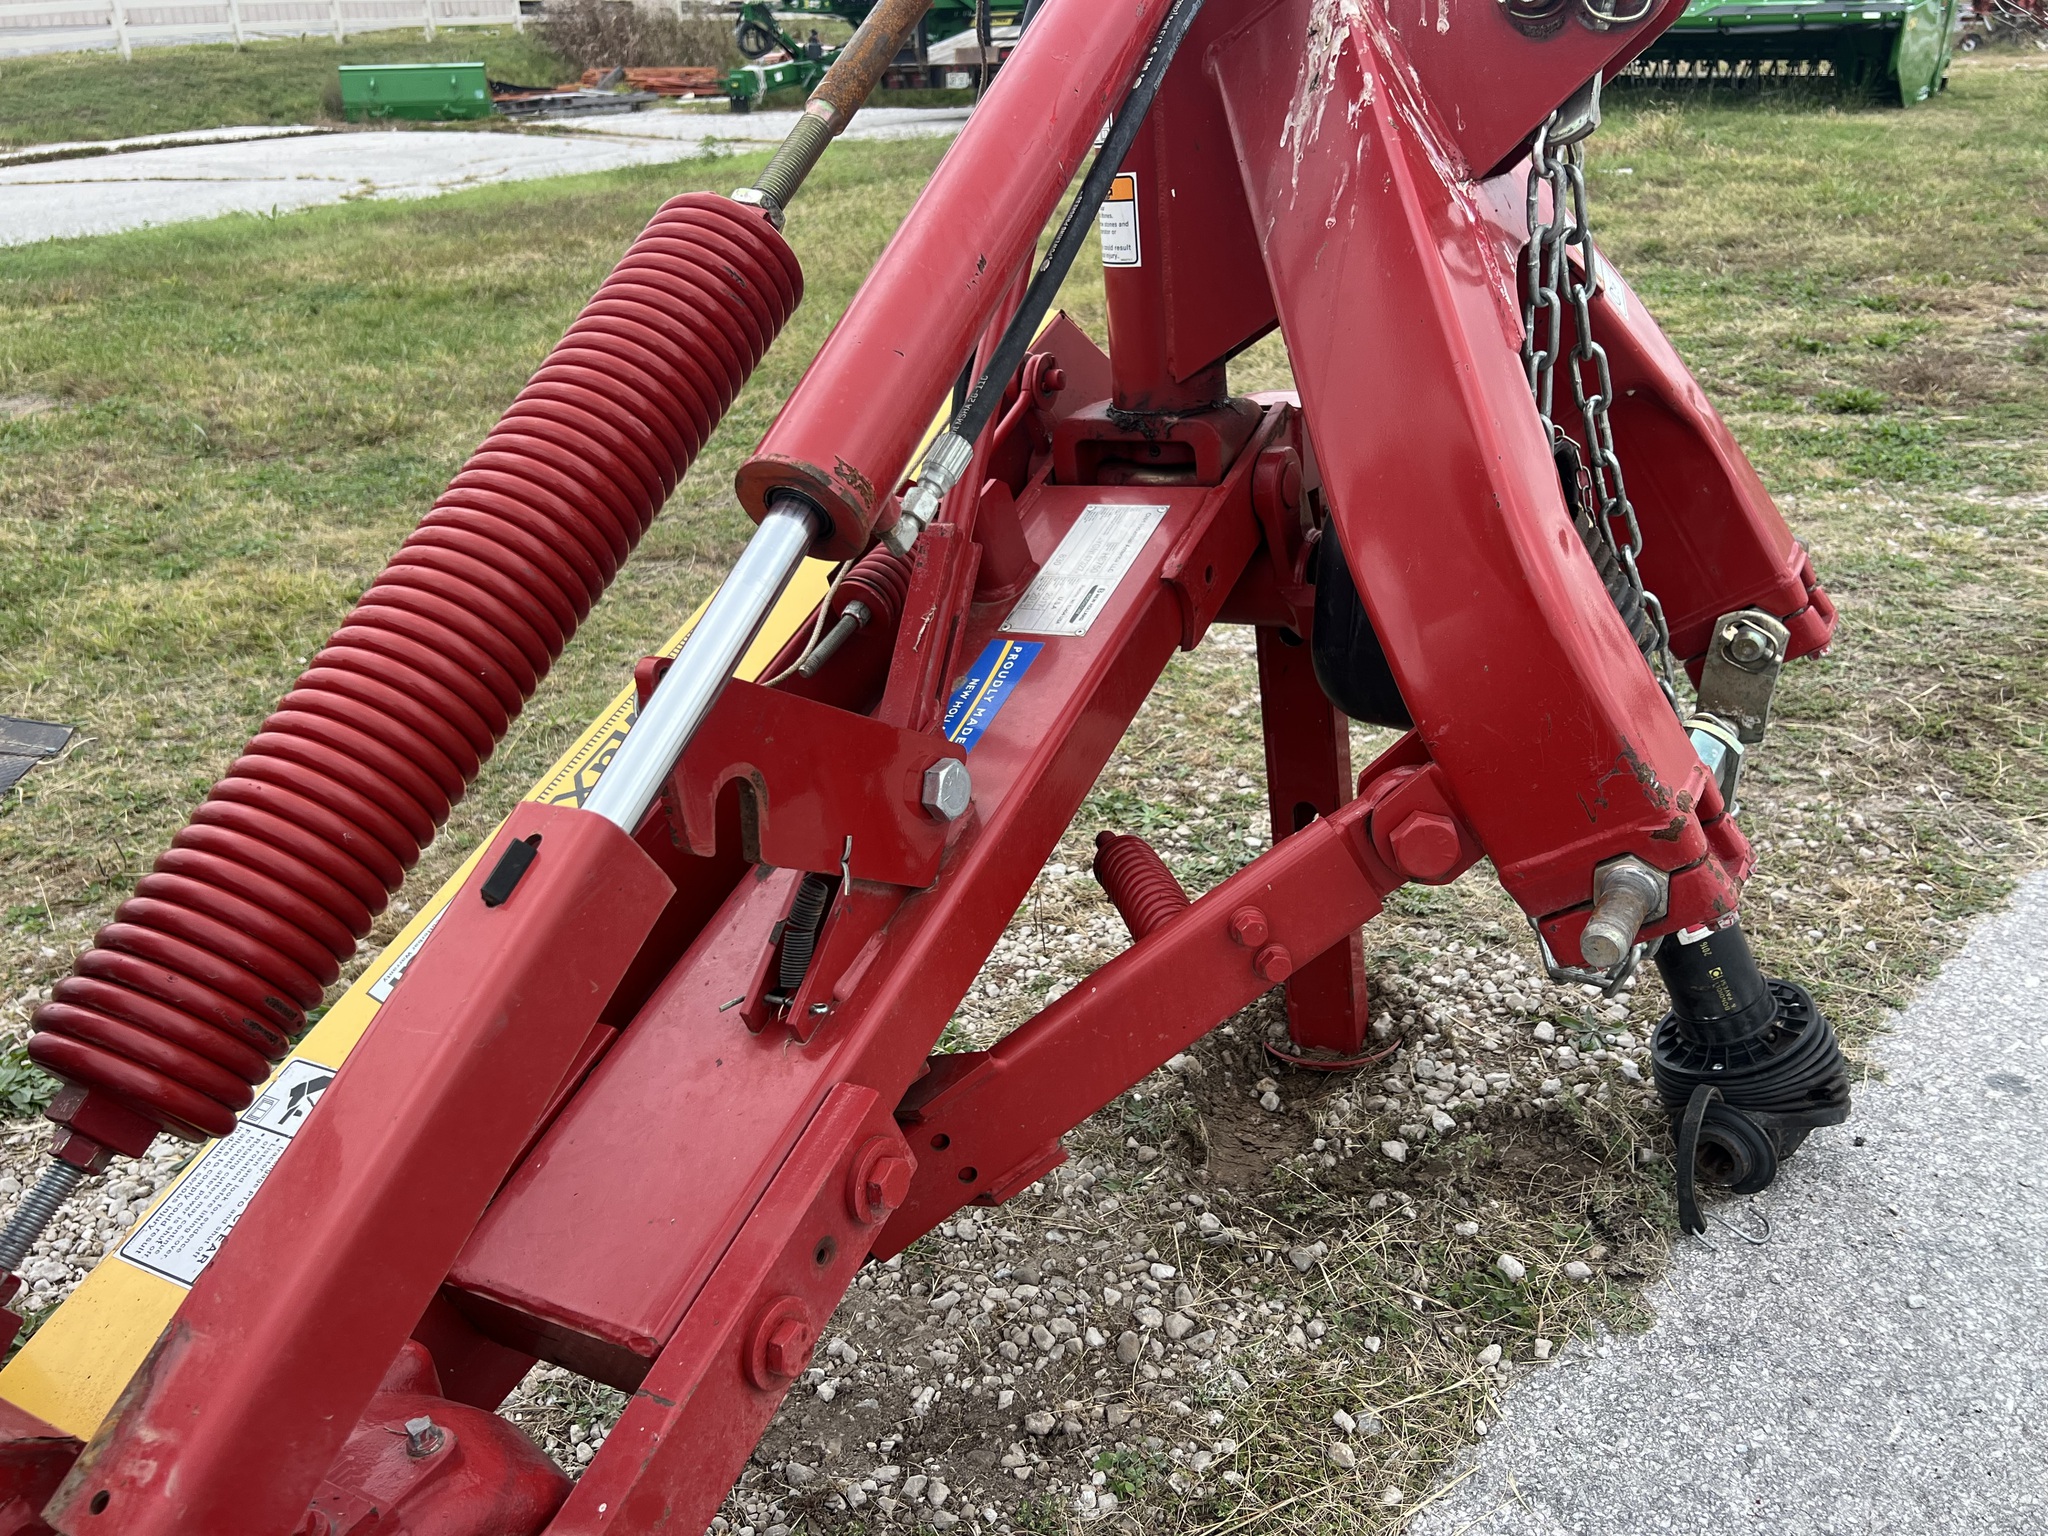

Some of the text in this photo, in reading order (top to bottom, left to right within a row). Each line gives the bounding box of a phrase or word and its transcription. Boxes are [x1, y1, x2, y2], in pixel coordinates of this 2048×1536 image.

[956, 375, 989, 425] MSHA 2G-11C
[954, 646, 1023, 744] PROUDLY MADE
[960, 678, 980, 700] NEW
[383, 952, 412, 982] Warranty
[147, 1126, 244, 1230] in death or serious injury.
[259, 1146, 284, 1172] tractor.
[135, 1128, 251, 1254] Failure to comply could result
[142, 1136, 255, 1259] to rotate after power is shut off.
[154, 1138, 261, 1255] Rotating cutters may continue
[161, 1141, 268, 1259] of rotation before lifting cover.
[176, 1143, 276, 1253] Listen and look for evidence
[237, 1190, 254, 1208] PTO
[204, 1226, 222, 1244] shut
[221, 1209, 236, 1225] and
[192, 1246, 204, 1258] off
